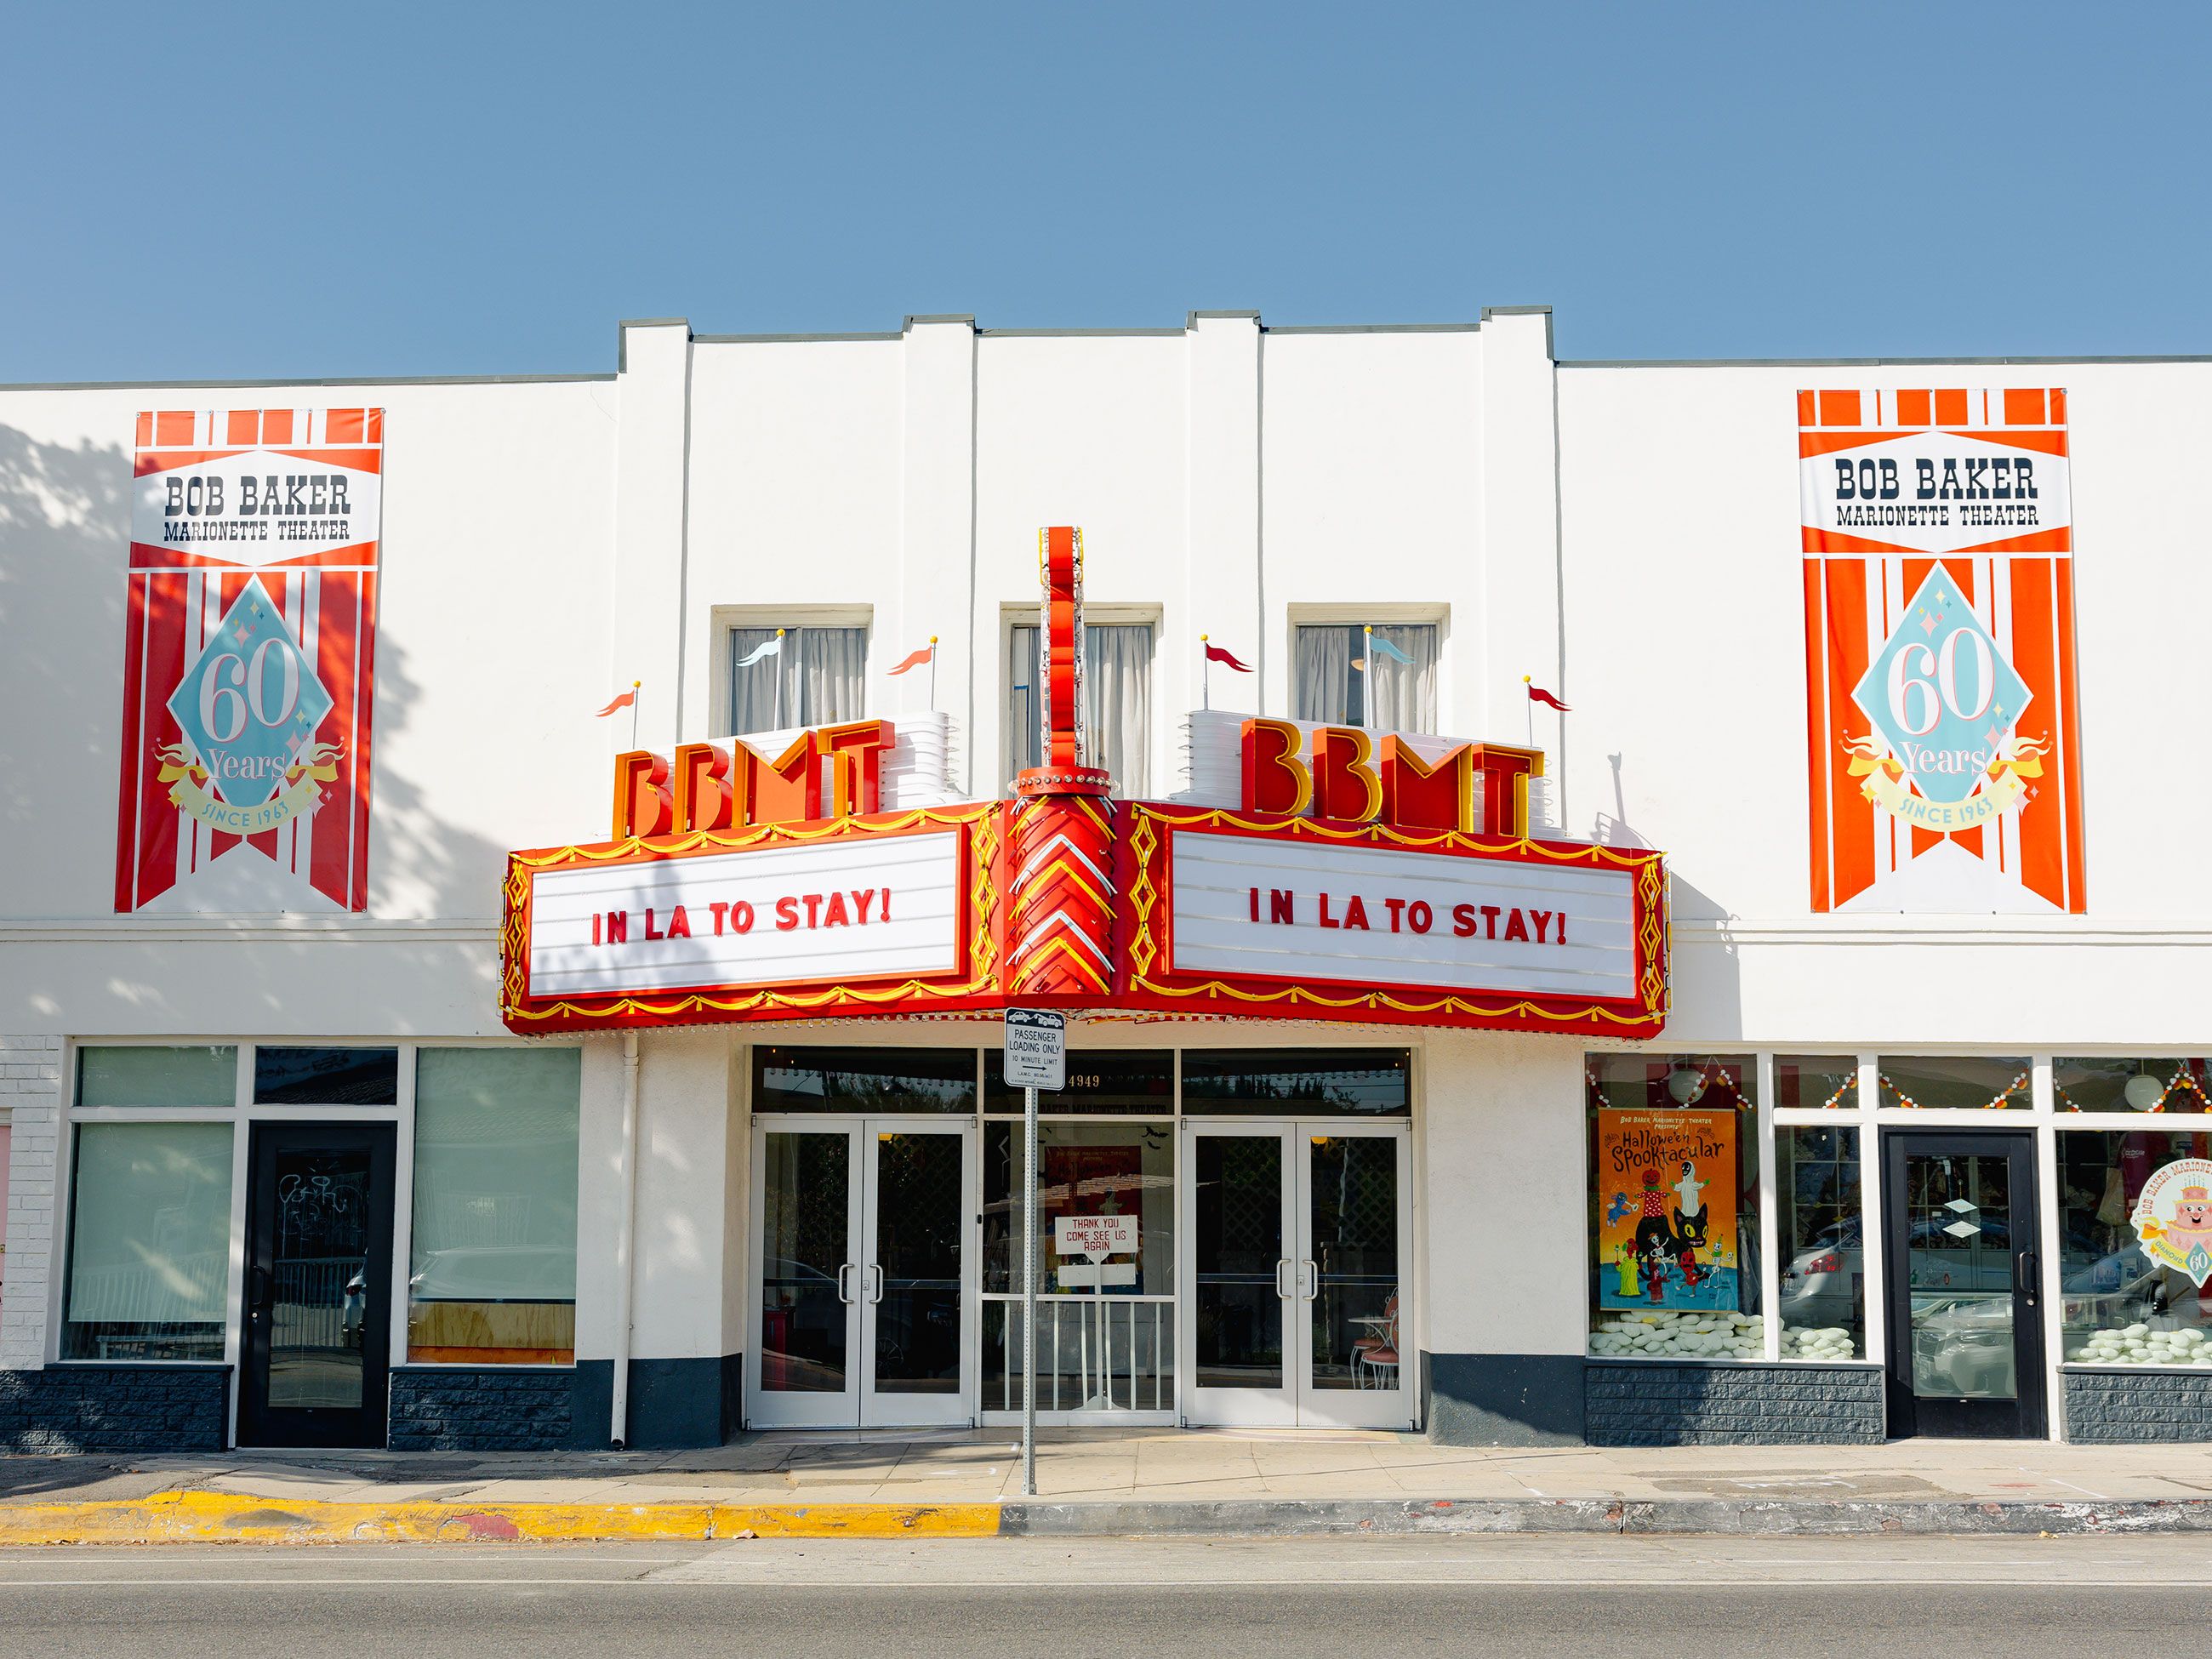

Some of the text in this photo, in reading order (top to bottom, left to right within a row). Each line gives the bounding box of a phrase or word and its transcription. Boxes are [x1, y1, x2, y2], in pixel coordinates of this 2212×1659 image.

[1835, 457, 2038, 500] BOB BAKER
[164, 475, 351, 516] BOB BAKER
[1836, 505, 2039, 527] MARIONETTE THEATER
[163, 520, 351, 542] MARIONETTE THEATER
[199, 637, 300, 744] 60
[1887, 626, 1996, 737] 60
[206, 748, 288, 781] Years
[1899, 740, 1988, 776] Years
[612, 719, 896, 841] BBMT
[1240, 717, 1546, 839] BBMT
[202, 800, 289, 827] SINCE 1963
[1898, 795, 1993, 824] SINCE 1963
[591, 887, 892, 947] IN LA TO STAY!
[1249, 887, 1568, 946] IN LA TO STAY!
[1009, 1040, 1061, 1055] LOADING ONLY
[1014, 1029, 1057, 1043] PASSENGER
[1021, 1056, 1041, 1064] MINUTE
[1068, 1075, 1100, 1087] 4949
[2146, 1171, 2172, 1197] BAKER
[2141, 1198, 2154, 1216] BOB
[1066, 1230, 1126, 1241] COME SEE US
[1072, 1217, 1120, 1229] THANK YOU
[1084, 1241, 1110, 1251] AGAIN
[2155, 1240, 2183, 1264] DIAMOND
[2189, 1251, 2209, 1272] 60
